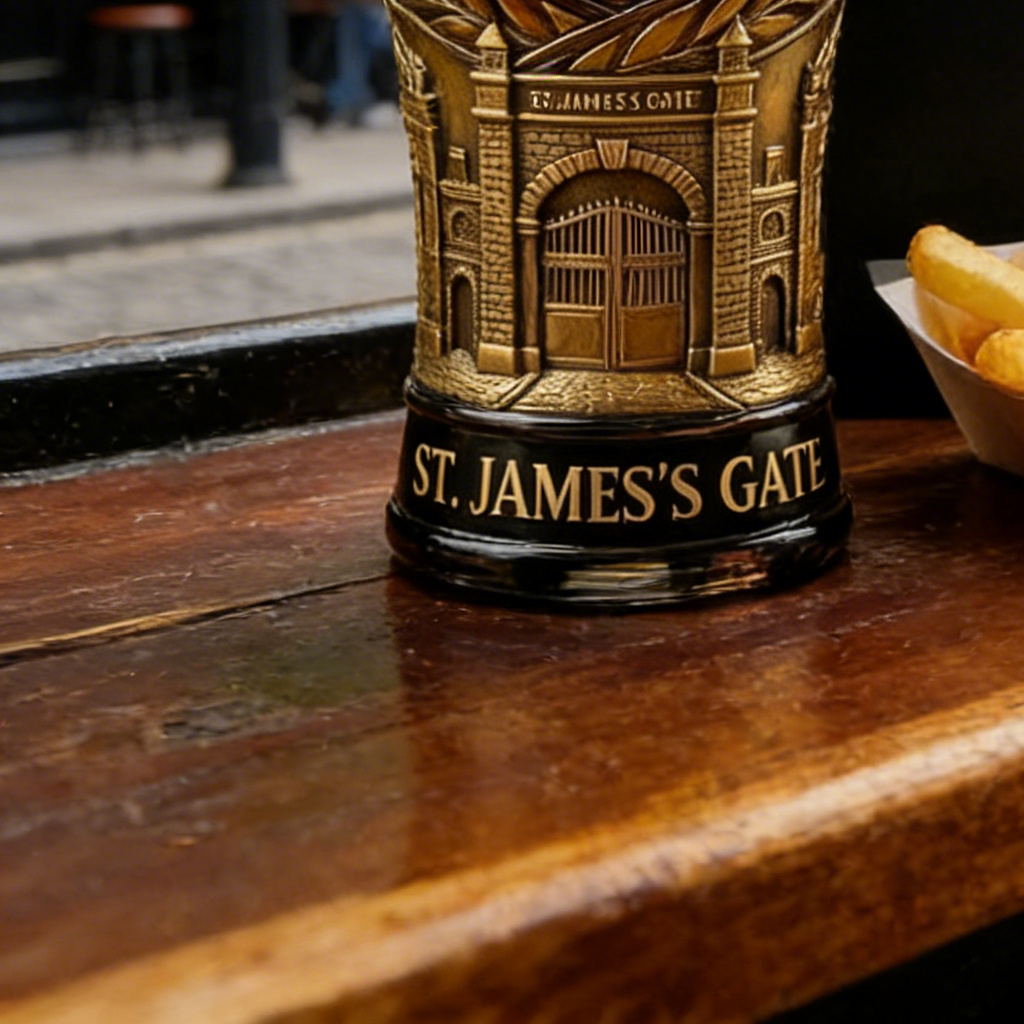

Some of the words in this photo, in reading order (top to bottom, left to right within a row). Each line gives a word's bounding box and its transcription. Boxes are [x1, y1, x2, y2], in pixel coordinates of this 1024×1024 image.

[412, 443, 460, 509] ST.
[469, 456, 703, 524] JAMES'S
[719, 437, 827, 514] GATE
